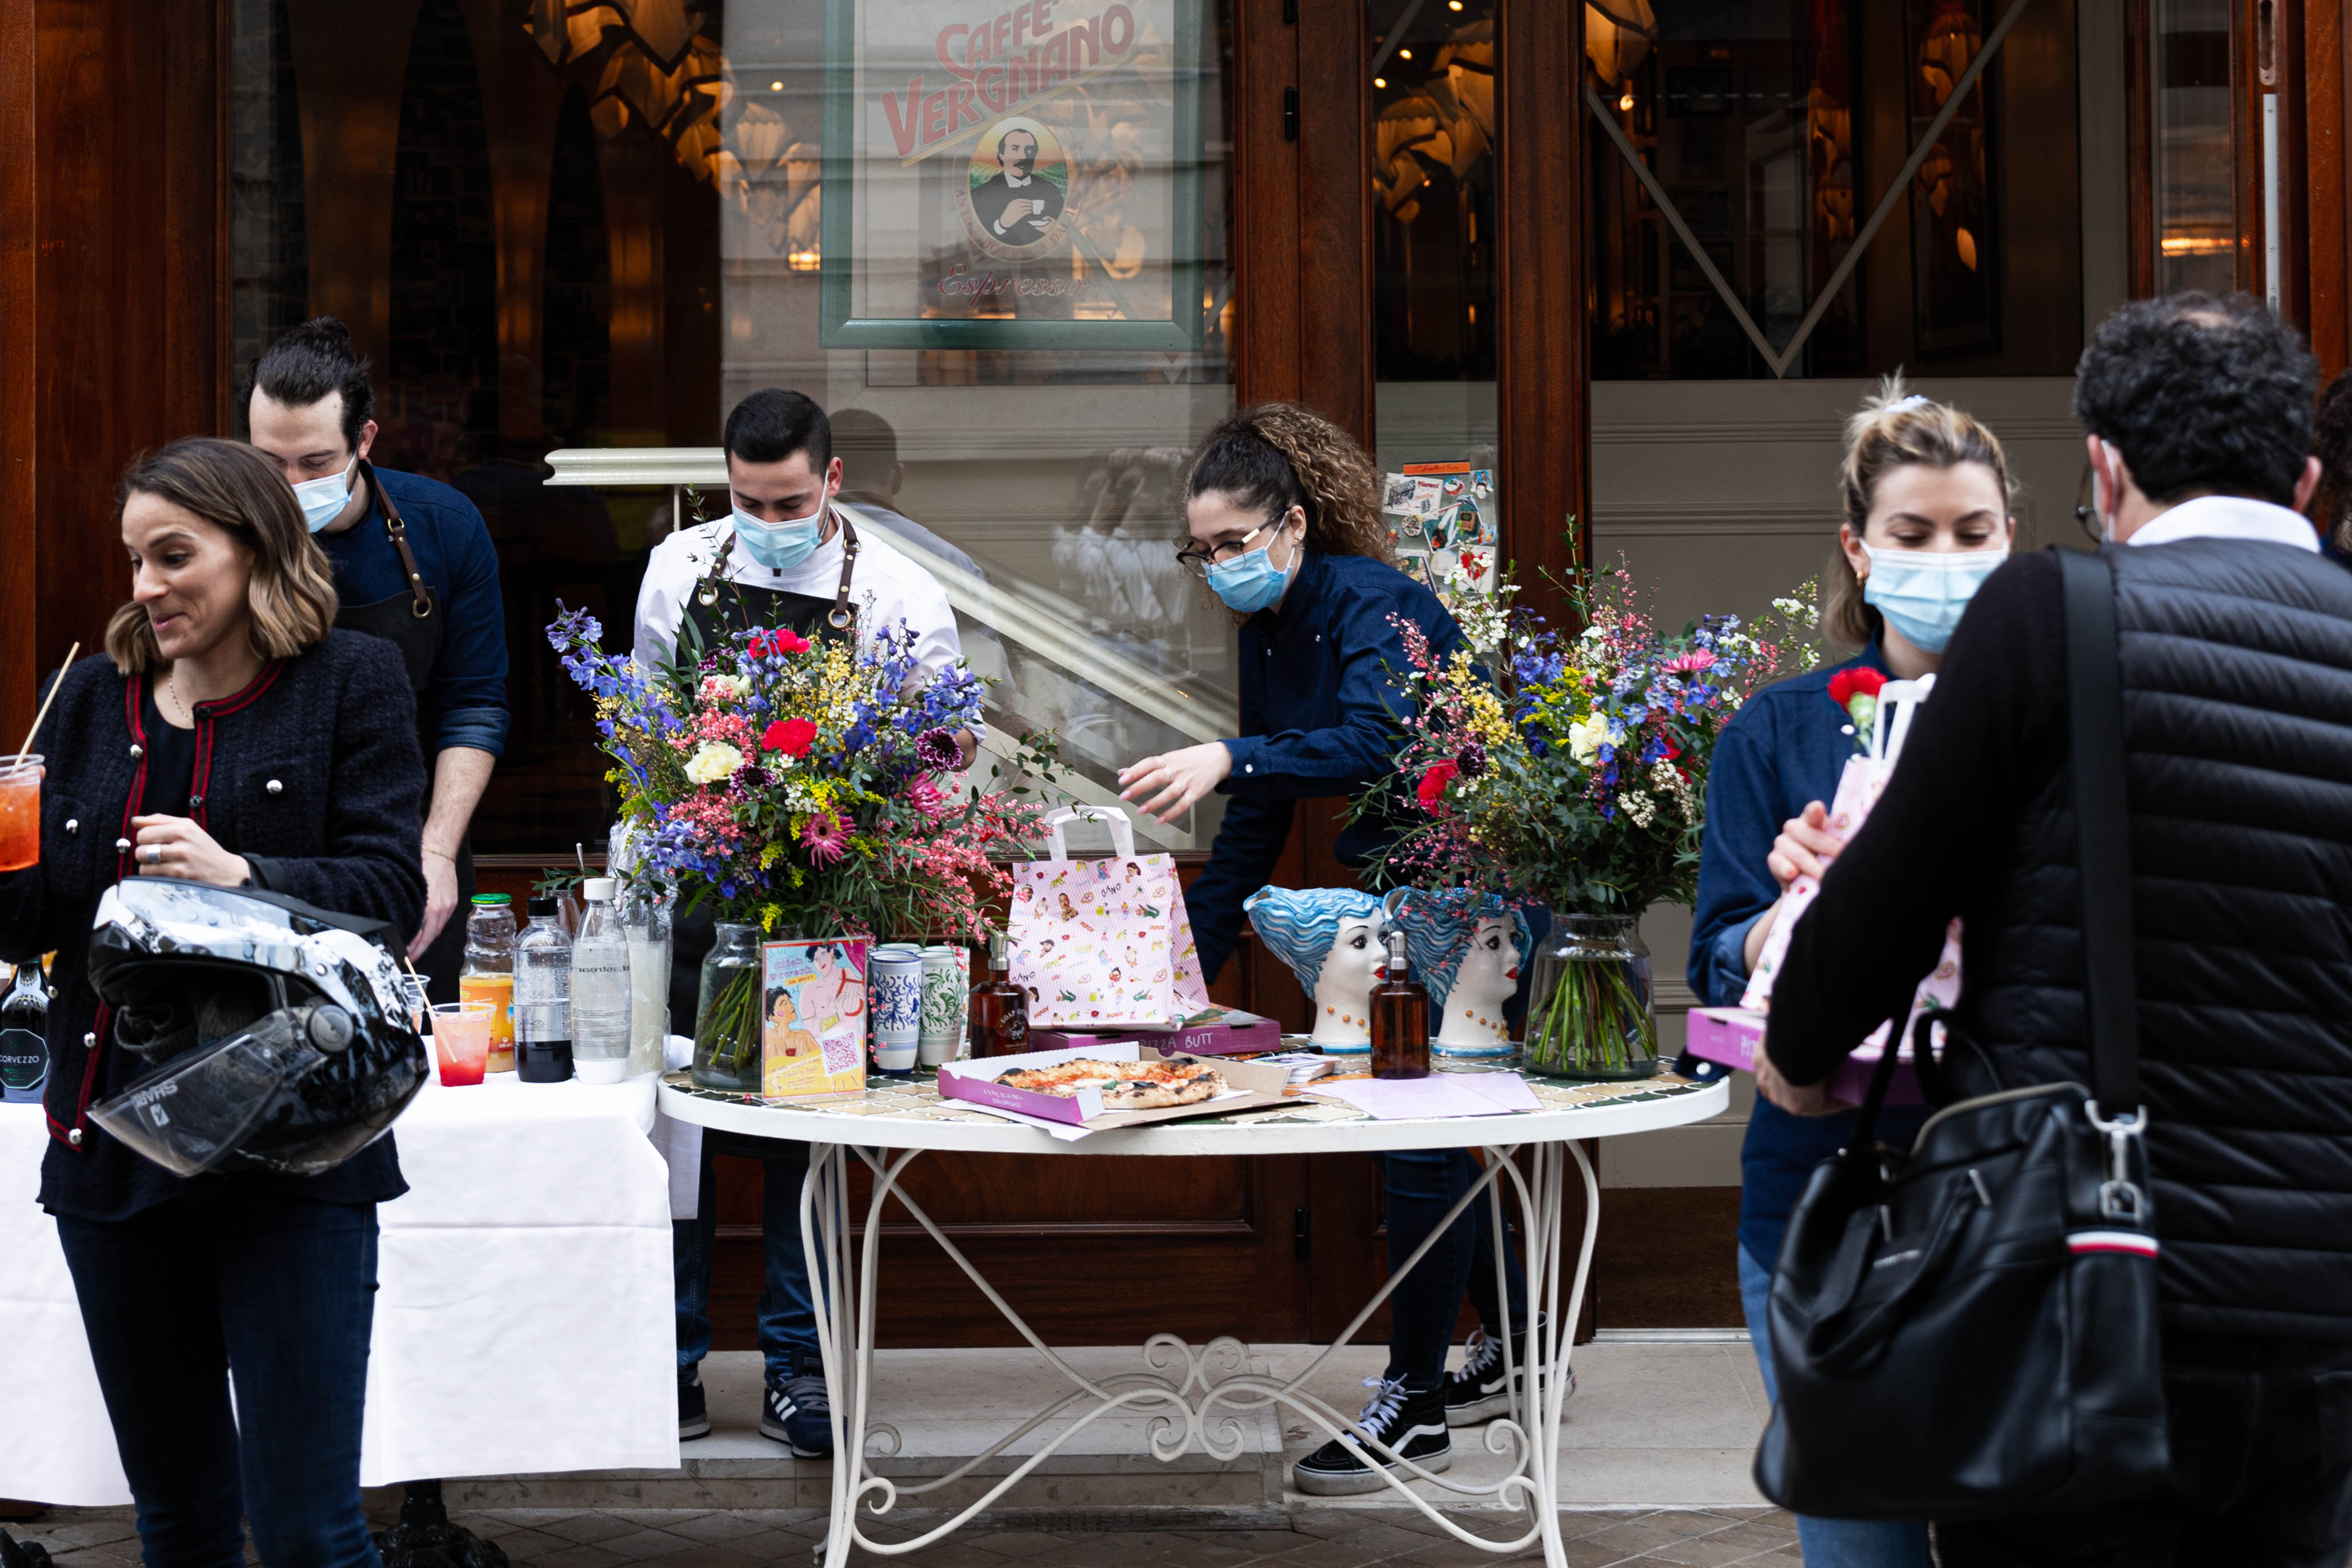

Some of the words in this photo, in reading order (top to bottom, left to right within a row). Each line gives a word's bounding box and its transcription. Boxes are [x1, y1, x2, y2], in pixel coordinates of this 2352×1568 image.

[882, 5, 1135, 157] VERGNANO
[937, 262, 1085, 307] Espresso
[1101, 883, 1121, 897] GANG
[774, 957, 803, 970] Click
[1012, 971, 1035, 982] GANG
[1000, 1010, 1015, 1024] SOAP
[1185, 1032, 1213, 1049] BUTT
